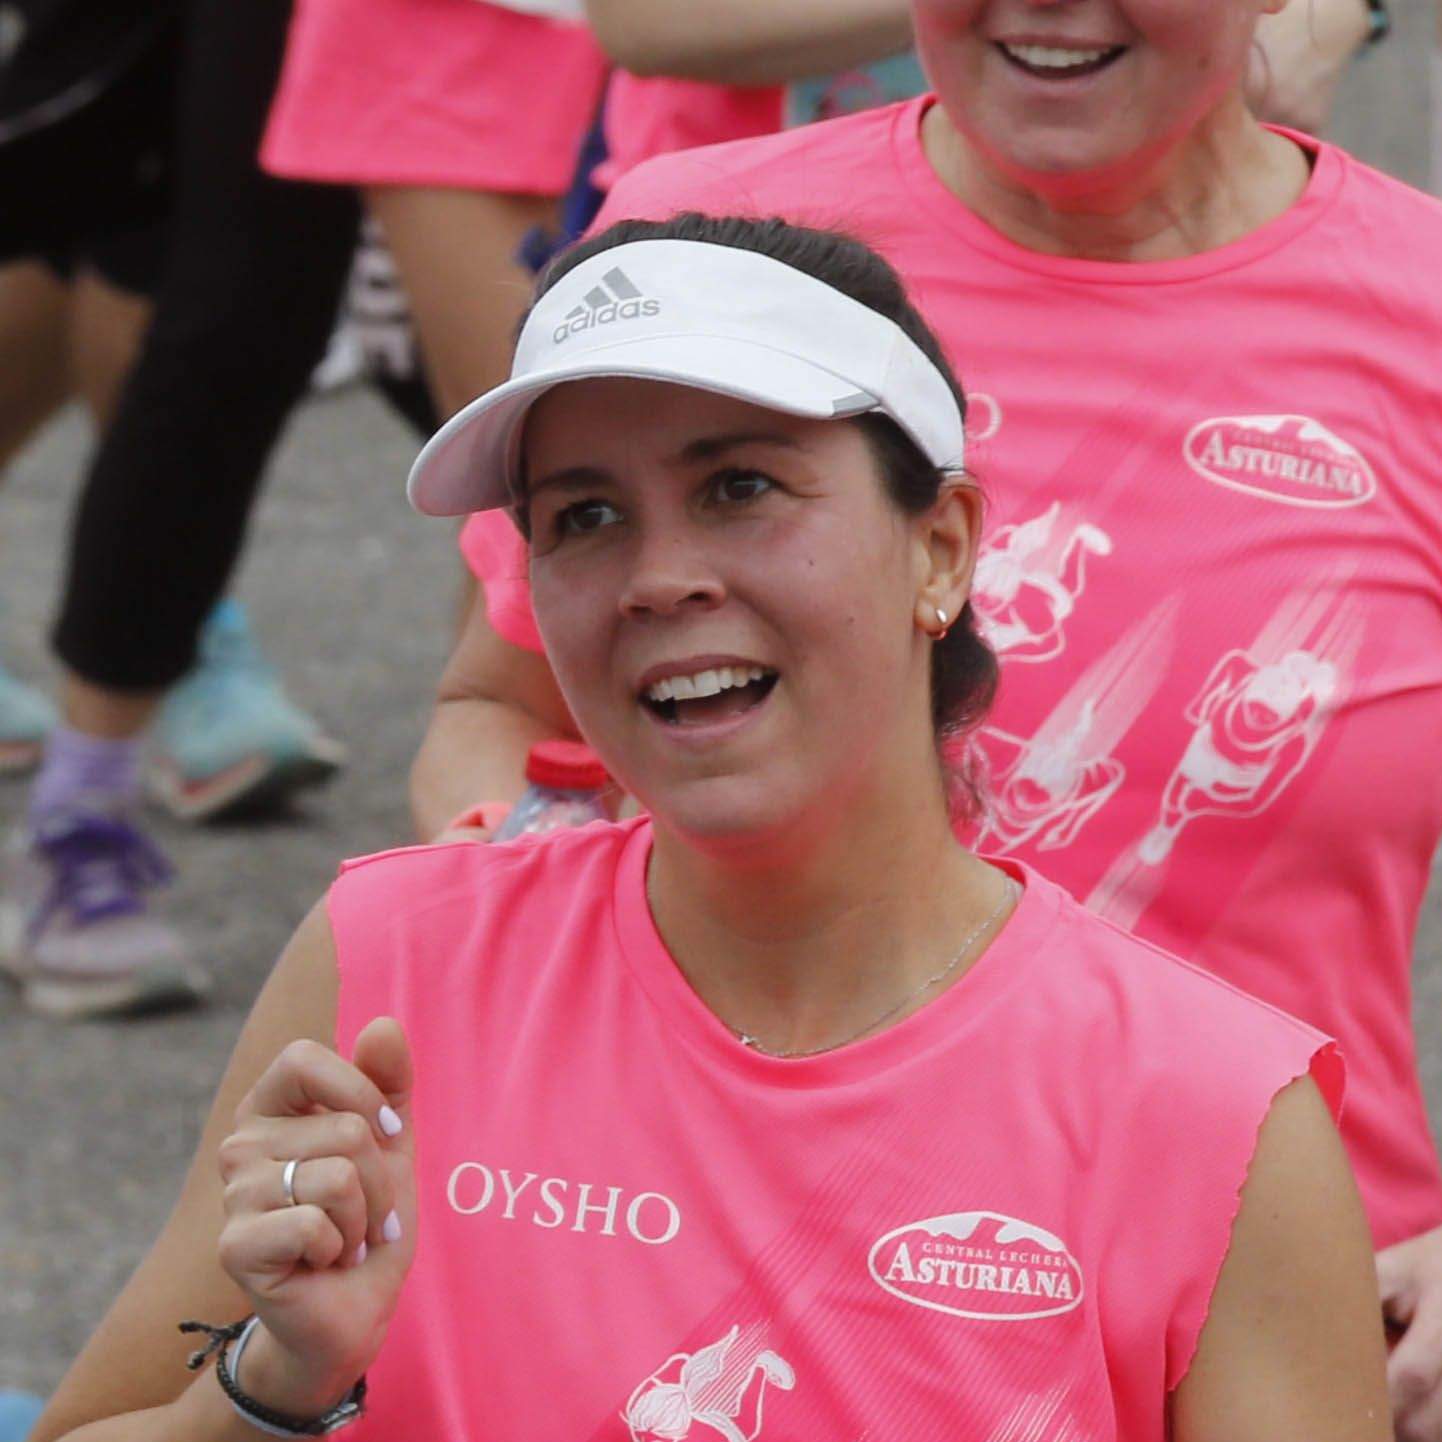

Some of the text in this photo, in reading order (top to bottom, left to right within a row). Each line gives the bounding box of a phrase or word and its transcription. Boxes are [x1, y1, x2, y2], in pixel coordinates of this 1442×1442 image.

[552, 299, 661, 345] adidas
[447, 1166, 681, 1245] OYSHO
[884, 1241, 1074, 1301] ASTURIANA
[922, 1241, 993, 1261] CENTRAL
